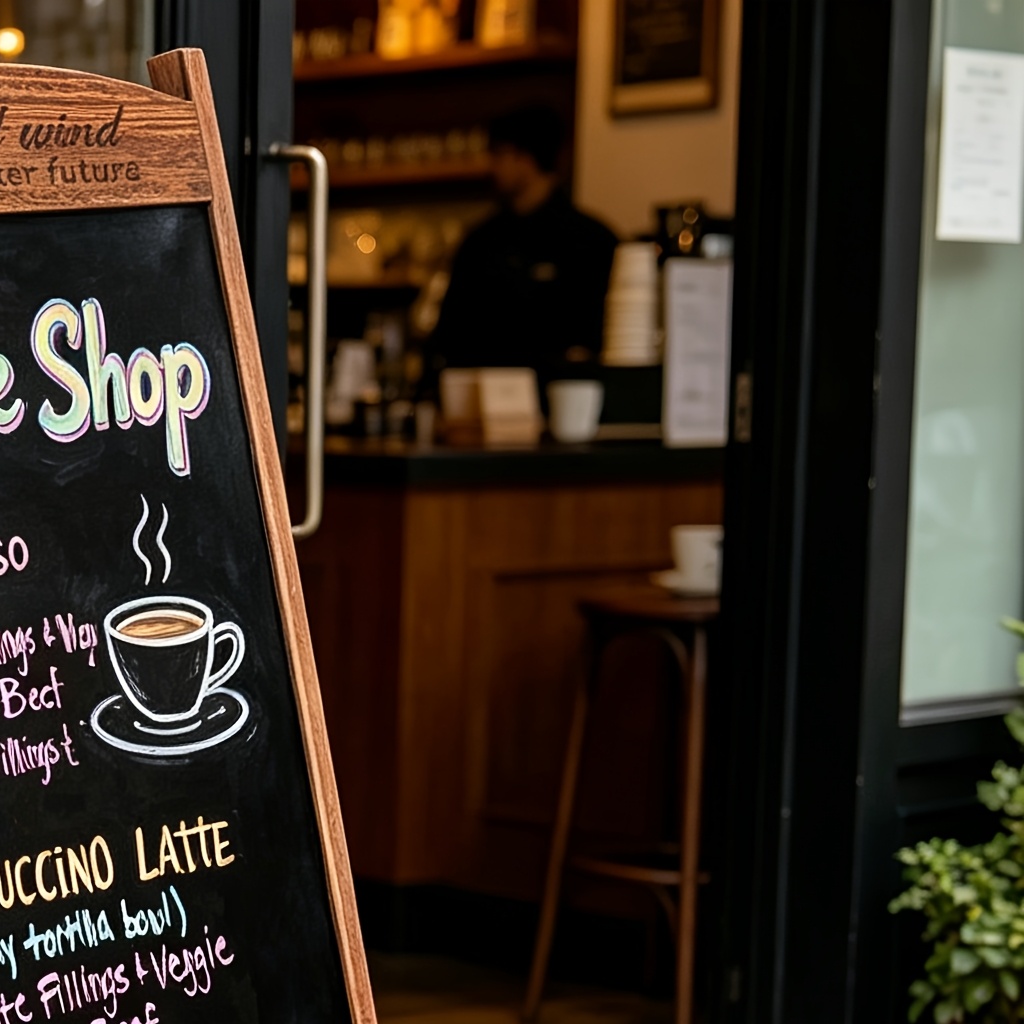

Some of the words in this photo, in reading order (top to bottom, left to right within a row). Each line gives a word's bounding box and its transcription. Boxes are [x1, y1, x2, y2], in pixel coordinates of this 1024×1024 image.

[19, 104, 124, 150] wind
[30, 297, 211, 477] Shop
[23, 909, 115, 961] tortilla
[121, 885, 187, 938] bowl)
[37, 964, 130, 1018] Fillings
[150, 925, 235, 997] Veggie
